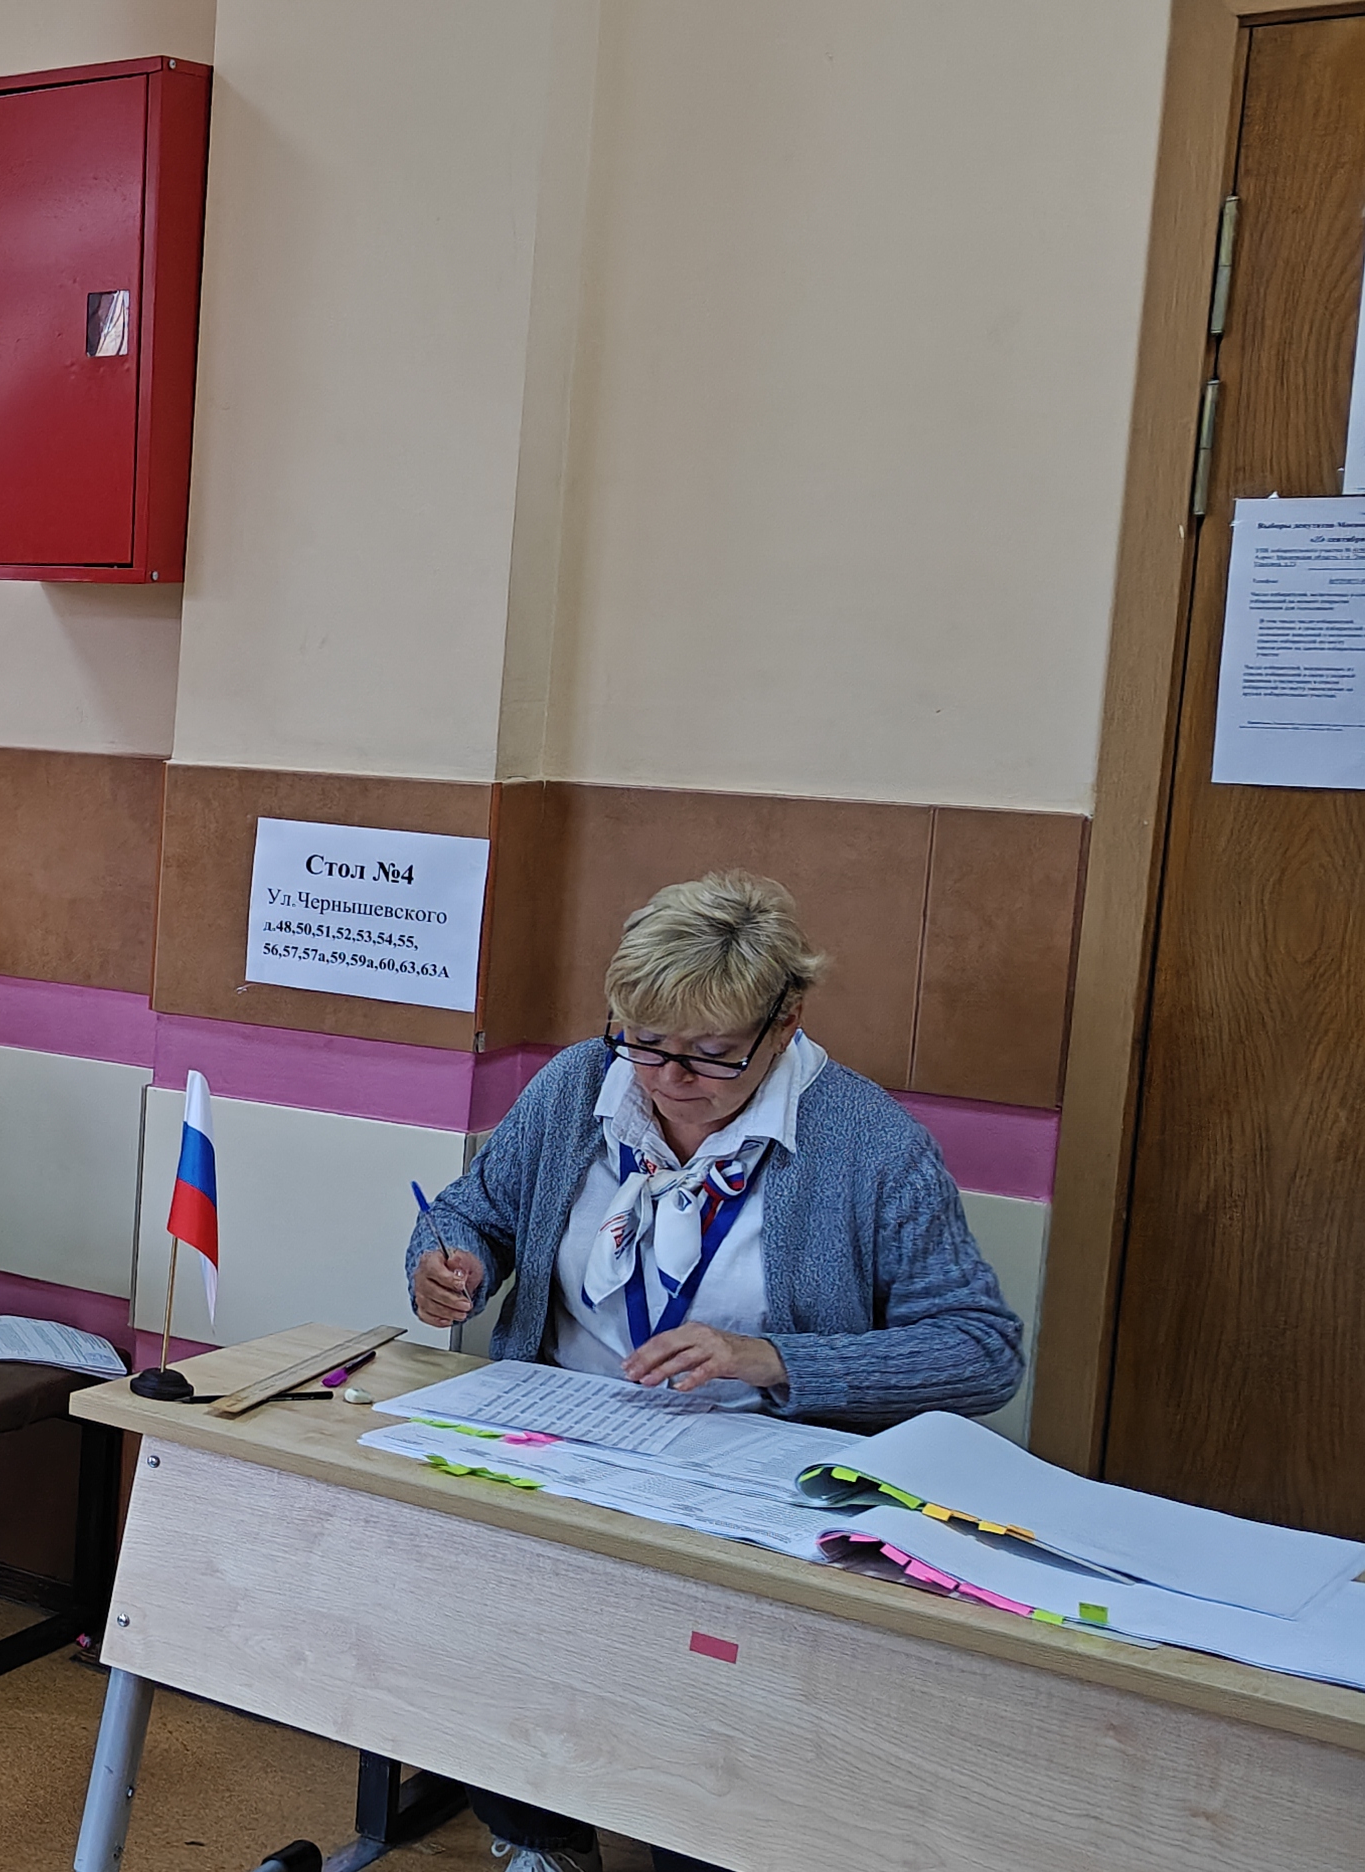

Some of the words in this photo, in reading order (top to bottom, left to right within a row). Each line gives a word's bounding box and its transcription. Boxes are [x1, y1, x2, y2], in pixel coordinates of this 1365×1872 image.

[305, 854, 366, 880] Стол
[372, 861, 415, 885] №4
[267, 887, 448, 925] Ул.Чернышевского
